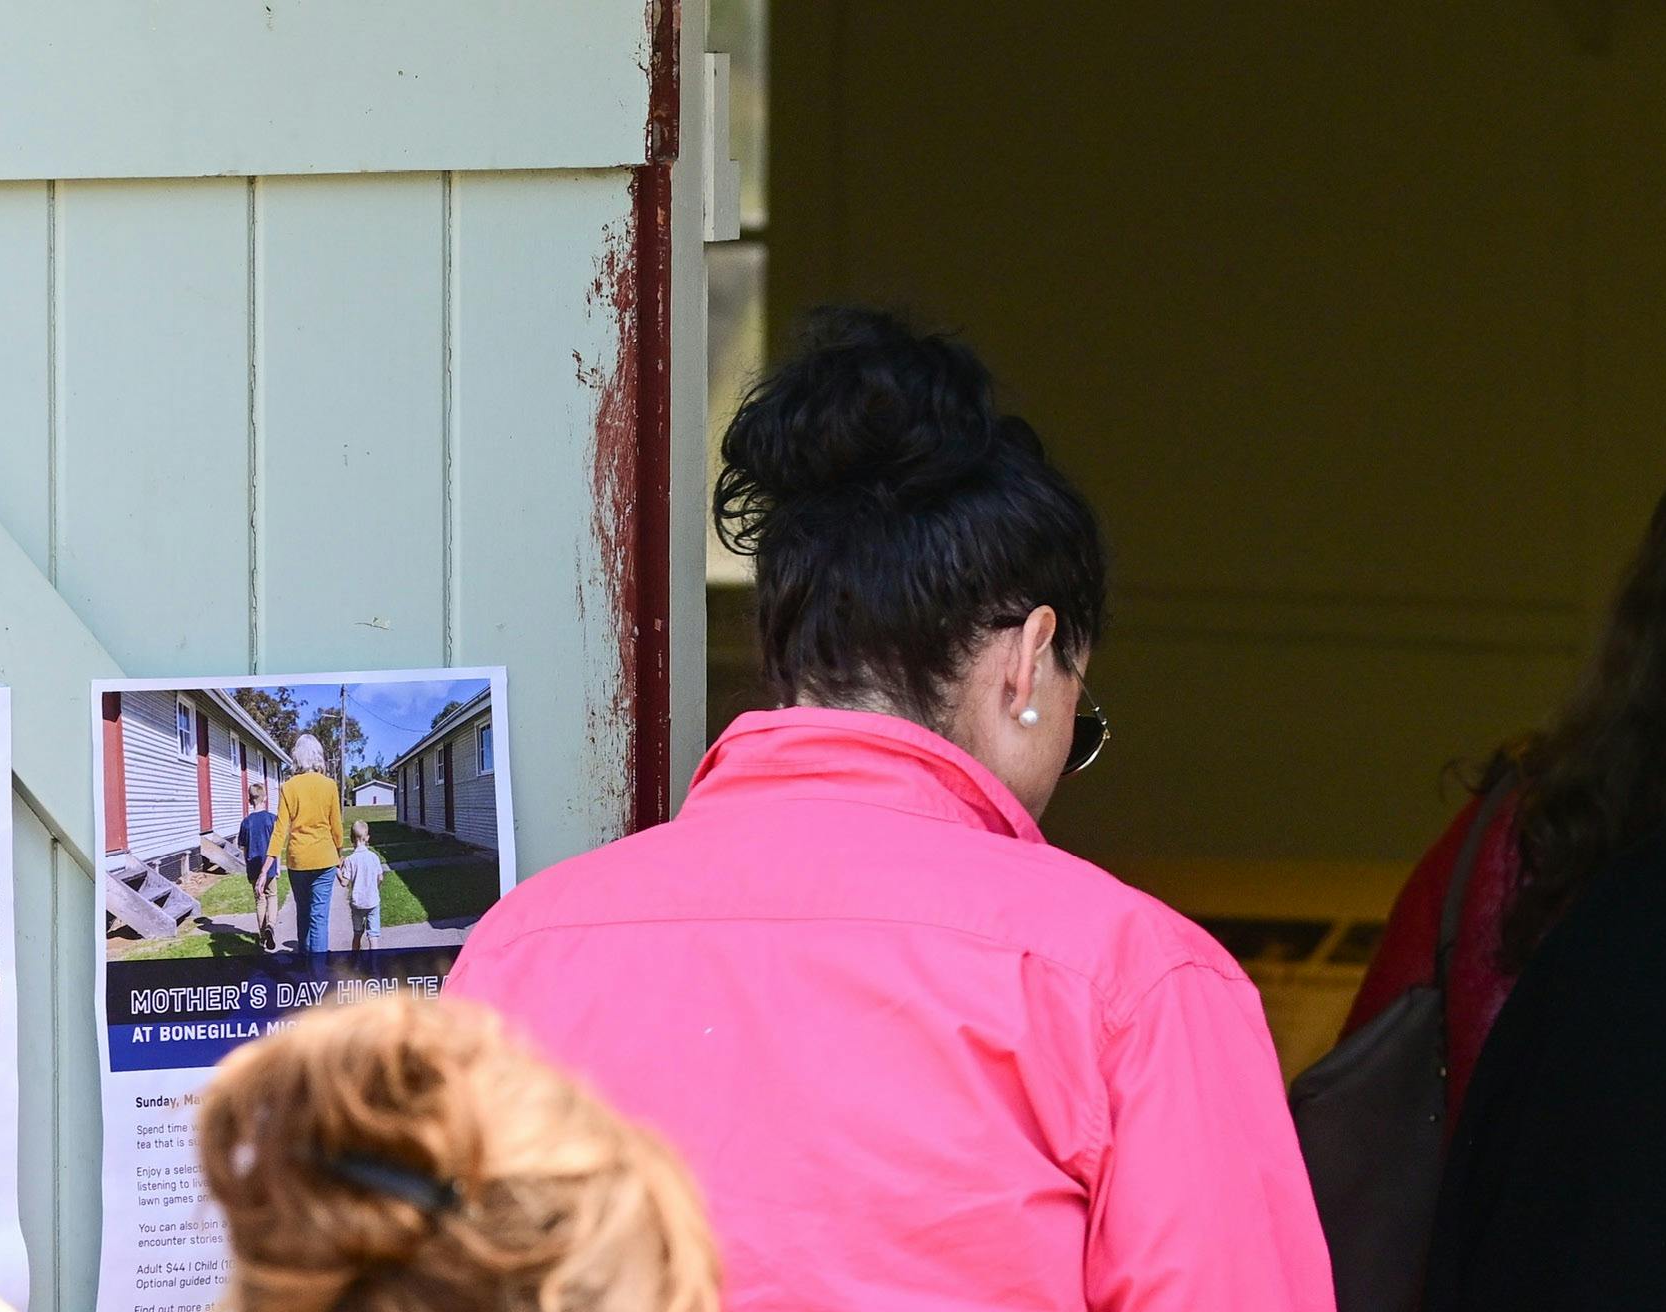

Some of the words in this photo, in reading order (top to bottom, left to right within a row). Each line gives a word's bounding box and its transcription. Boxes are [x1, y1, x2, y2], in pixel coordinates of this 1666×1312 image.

[130, 981, 267, 1015] MOTHER'S
[276, 981, 329, 1008] DAY
[337, 977, 398, 1005] HIGH
[132, 1026, 153, 1043] AT
[159, 1022, 260, 1042] BONEGILLA
[135, 1095, 180, 1109] Sunday,
[136, 1124, 164, 1137] Spend
[167, 1123, 188, 1133] time
[136, 1140, 151, 1149] tea
[154, 1138, 174, 1149] that
[176, 1138, 185, 1147] is
[136, 1166, 161, 1179] Enjoy
[164, 1167, 171, 1175] a
[137, 1180, 177, 1191] listening
[179, 1180, 189, 1189] to
[138, 1195, 160, 1206] lawn
[163, 1194, 194, 1207] games
[138, 1223, 156, 1233] You
[159, 1223, 176, 1232] can
[179, 1220, 199, 1231] also
[201, 1220, 218, 1232] join
[138, 1236, 186, 1248] encounter
[190, 1235, 223, 1245] stories
[136, 1263, 162, 1275] Adult
[166, 1262, 185, 1274] $44
[194, 1260, 218, 1272] Child
[136, 1278, 177, 1290] Optional
[179, 1275, 211, 1289] guided
[177, 1303, 202, 1312] more
